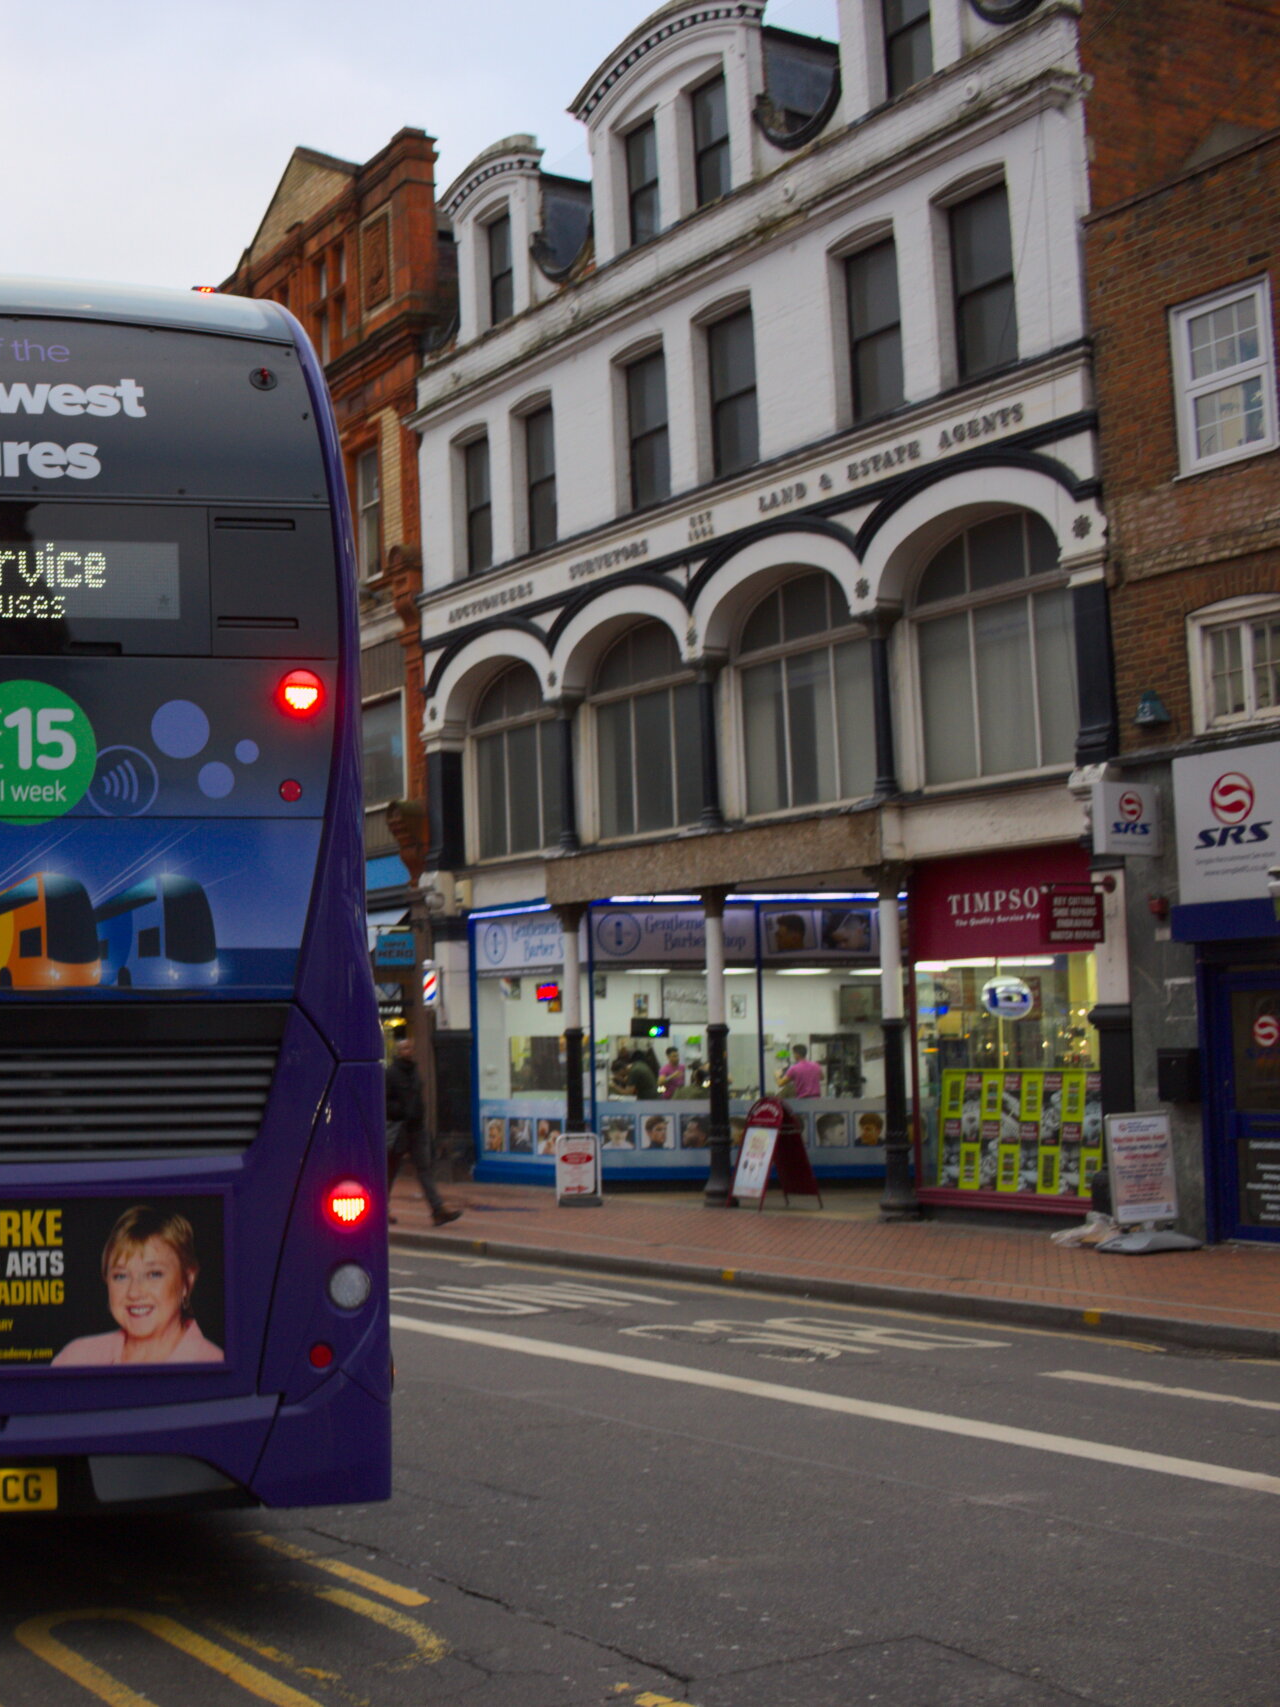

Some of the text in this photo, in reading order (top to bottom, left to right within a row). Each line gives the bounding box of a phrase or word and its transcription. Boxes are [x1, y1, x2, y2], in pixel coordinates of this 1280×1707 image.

[9, 337, 71, 363] the
[568, 538, 648, 580] SURVEYORS
[758, 481, 808, 513] LAND
[819, 472, 833, 491] &
[846, 439, 922, 482] ESTATE
[938, 403, 1024, 450] AGENTS
[11, 778, 67, 803] week
[1111, 821, 1153, 835] SRS
[1193, 820, 1273, 851] SRS
[947, 884, 1048, 917] TIMPSO
[6, 1250, 64, 1278] ARTS
